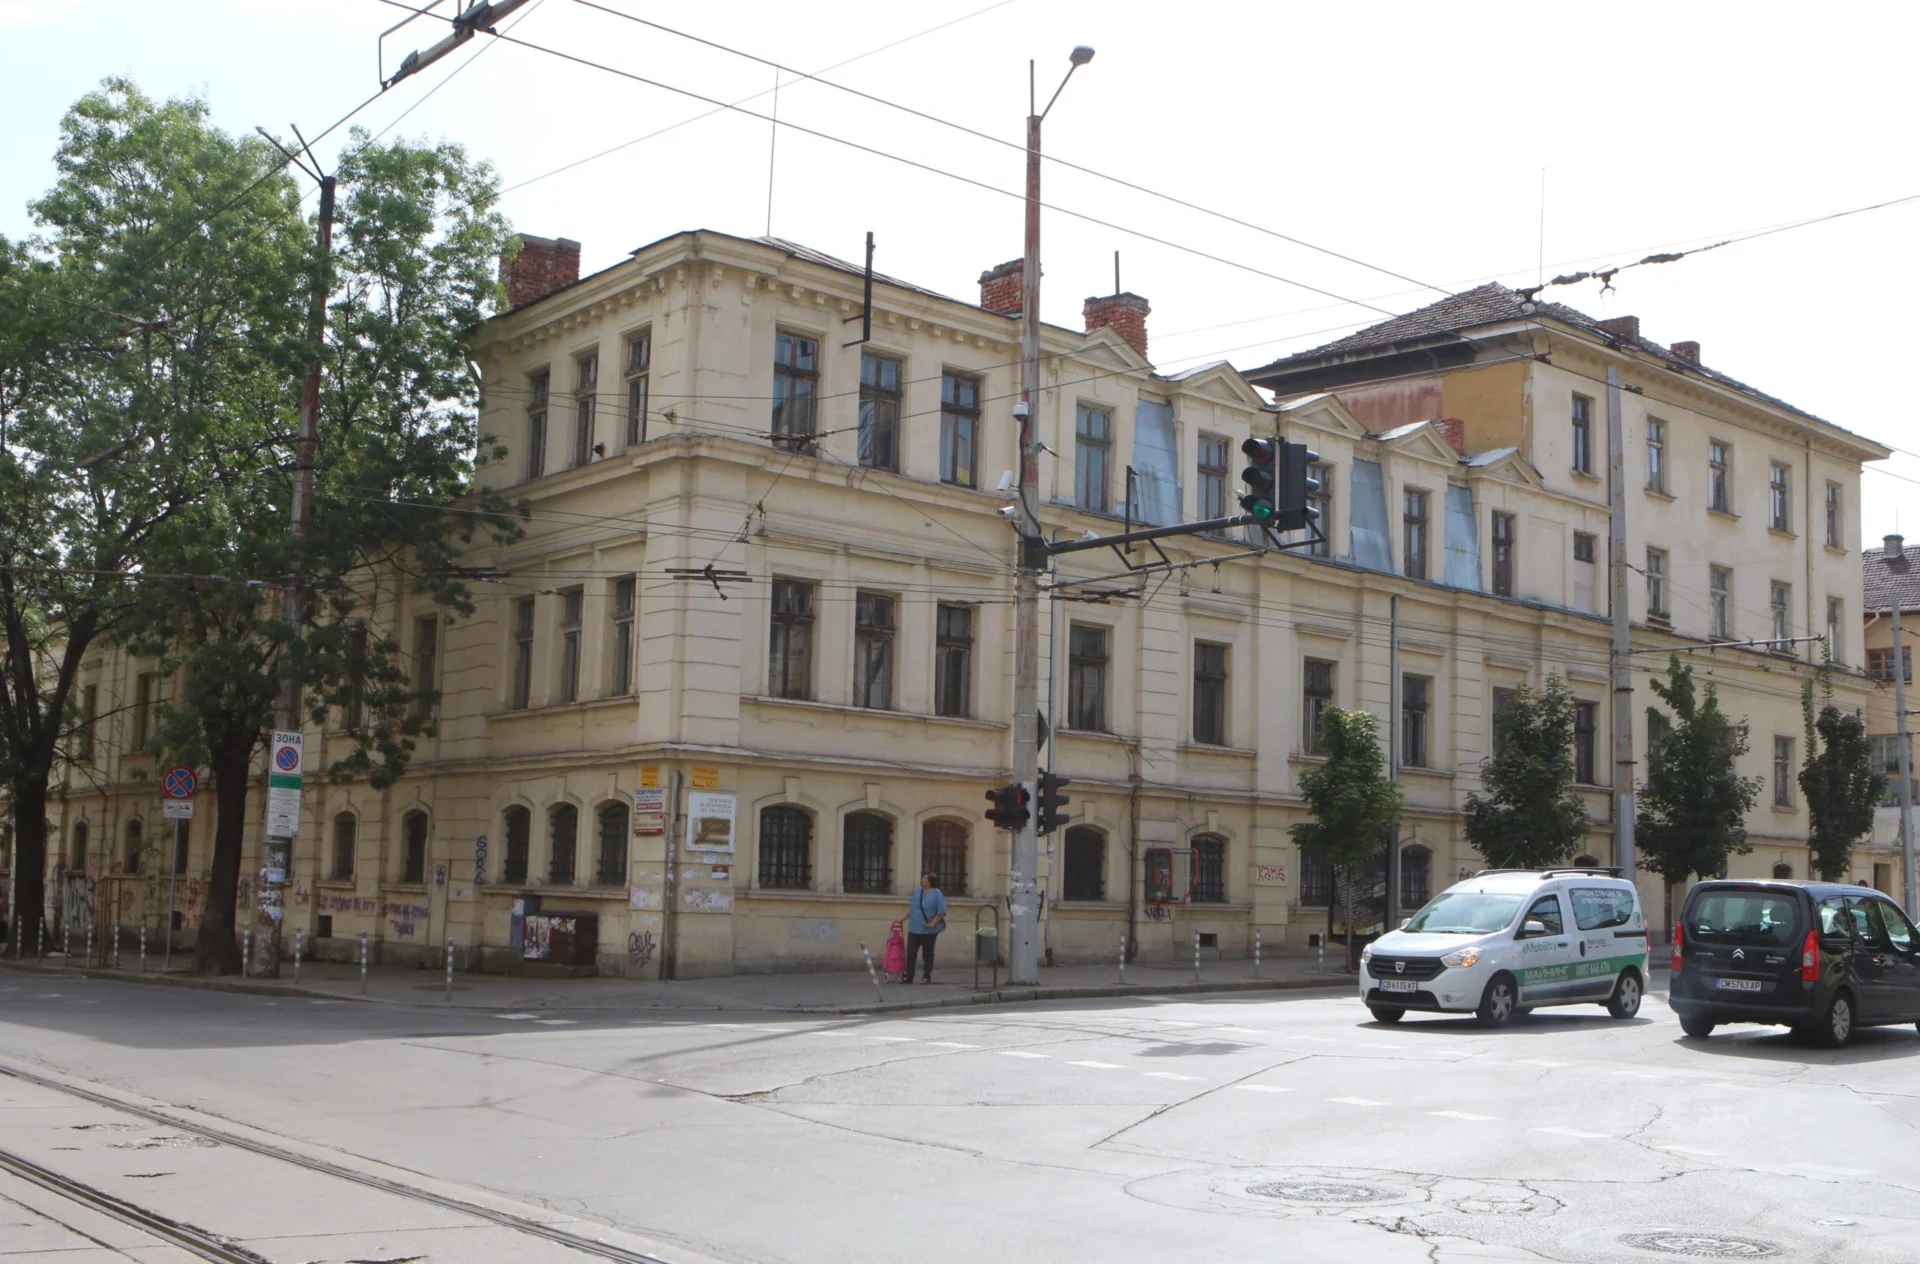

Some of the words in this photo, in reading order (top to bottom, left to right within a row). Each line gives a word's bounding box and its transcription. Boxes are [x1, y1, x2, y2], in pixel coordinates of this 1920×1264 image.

[275, 733, 302, 745] ЗОНА
[1522, 941, 1557, 954] eMobility
[1524, 966, 1568, 979] МАЙНИНГ
[1392, 981, 1406, 989] 6115
[1408, 981, 1416, 989] AT
[1731, 980, 1749, 989] 5763
[1750, 982, 1760, 990] AP
